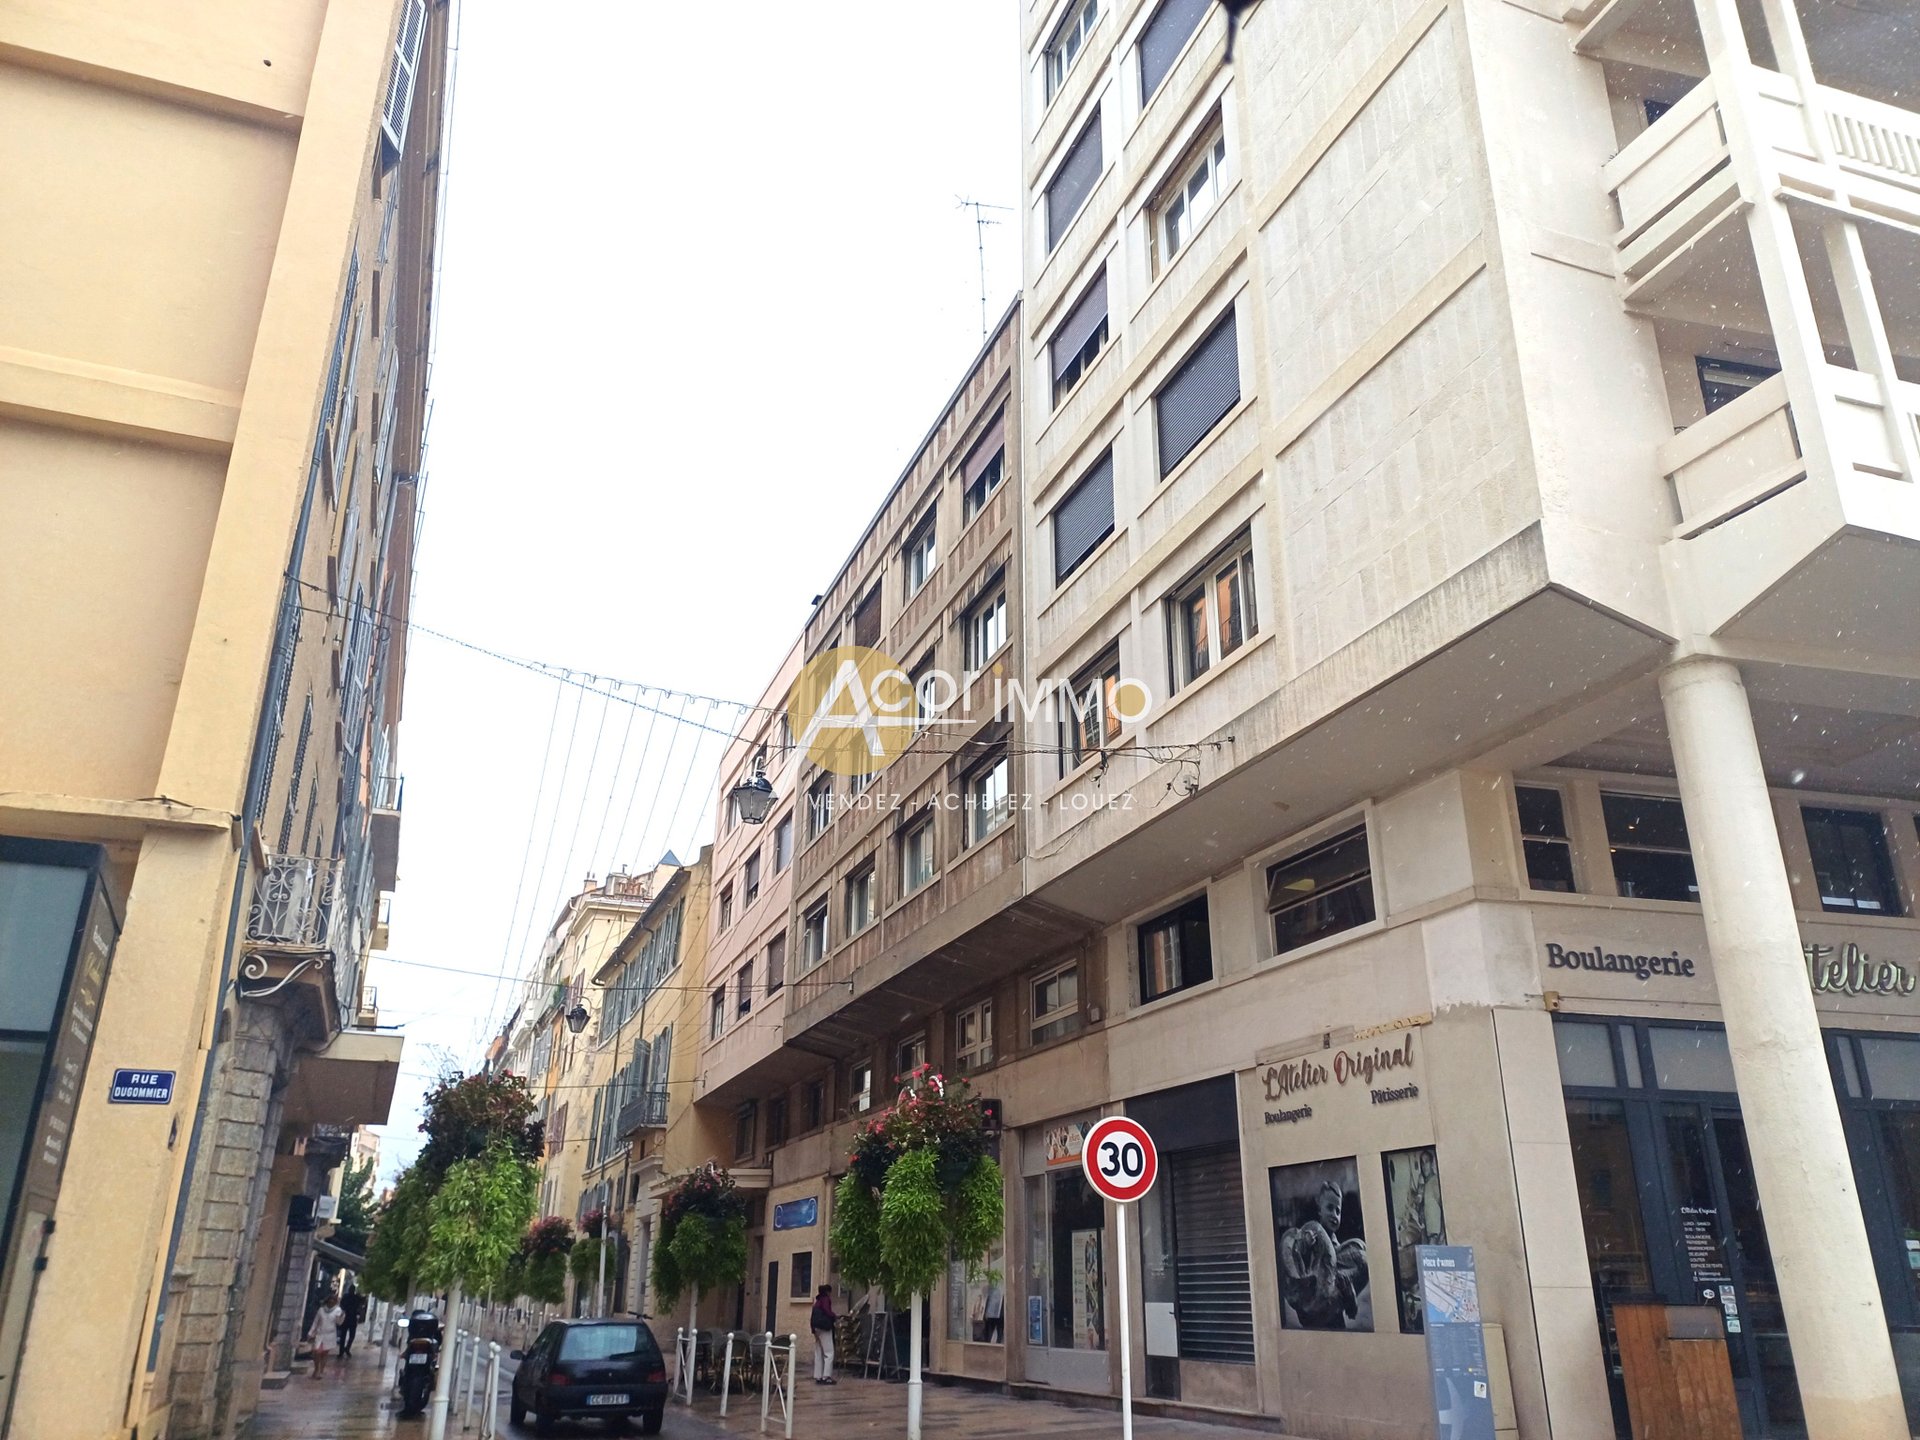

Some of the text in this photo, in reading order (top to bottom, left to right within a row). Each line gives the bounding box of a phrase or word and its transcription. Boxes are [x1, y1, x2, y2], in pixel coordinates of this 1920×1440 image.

[1545, 943, 1696, 981] Boulangerie
[1803, 942, 1917, 996] telier
[131, 1073, 159, 1085] RUE
[1262, 1032, 1414, 1101] L'Atelier Original
[114, 1086, 168, 1099] DUGOMMIER
[1370, 1082, 1419, 1105] Pâtisserie
[1264, 1104, 1313, 1125] Boulangerie
[1100, 1141, 1144, 1178] 30
